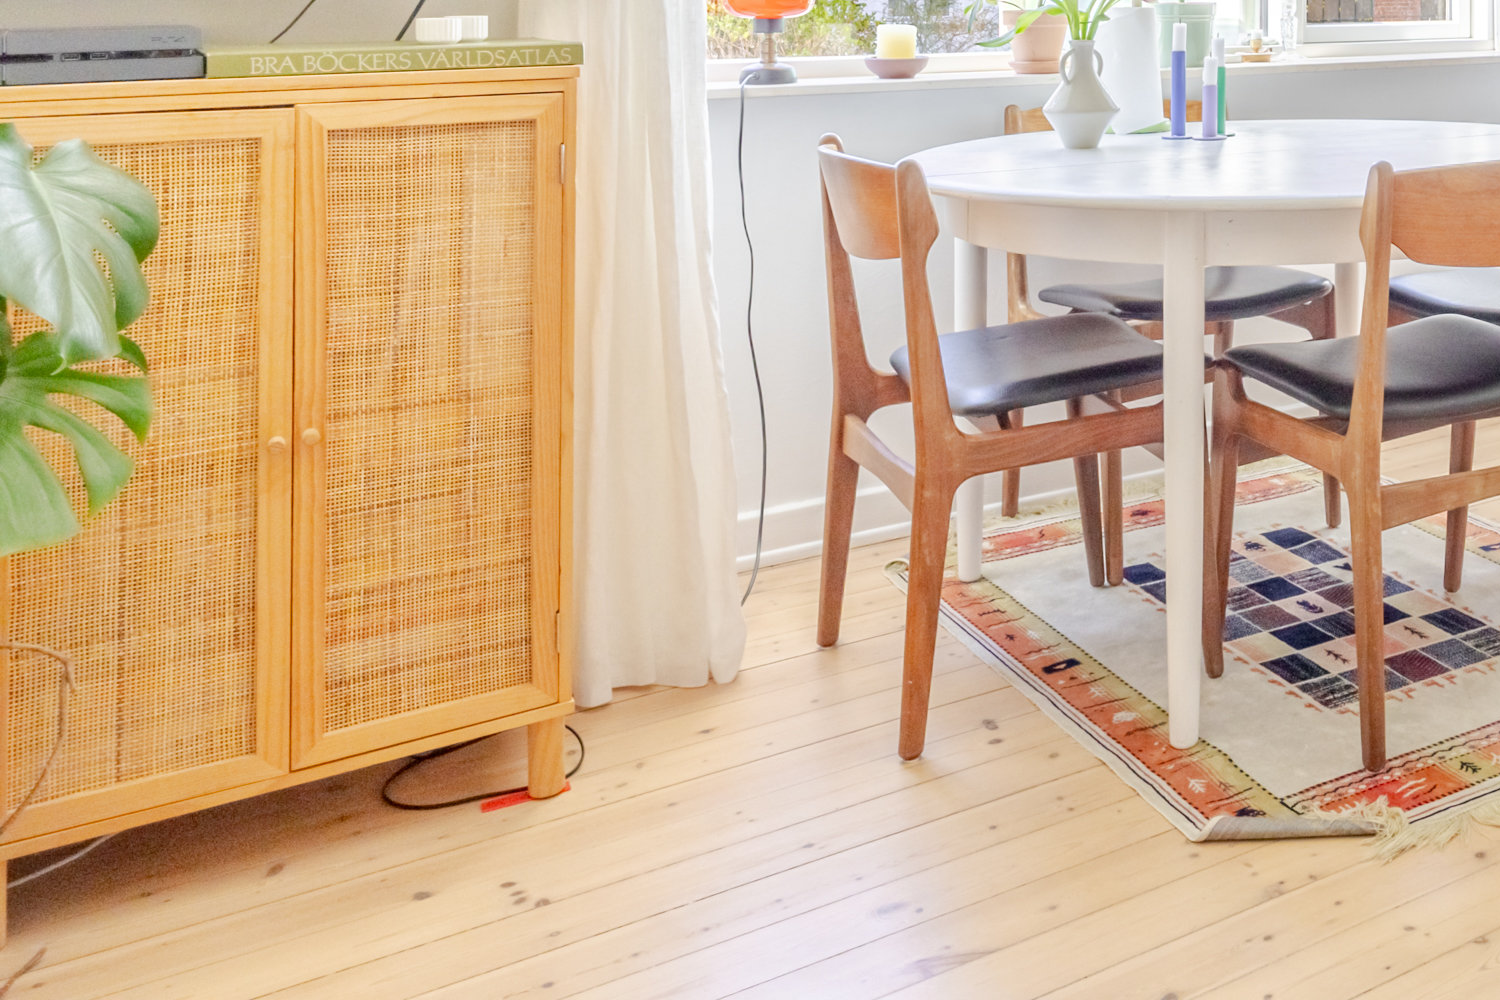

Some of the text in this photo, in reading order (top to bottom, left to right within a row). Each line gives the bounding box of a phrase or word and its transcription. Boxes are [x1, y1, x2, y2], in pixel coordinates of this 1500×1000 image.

[249, 46, 573, 75] BRA BÖCKERS VÄRLDSATLAS
